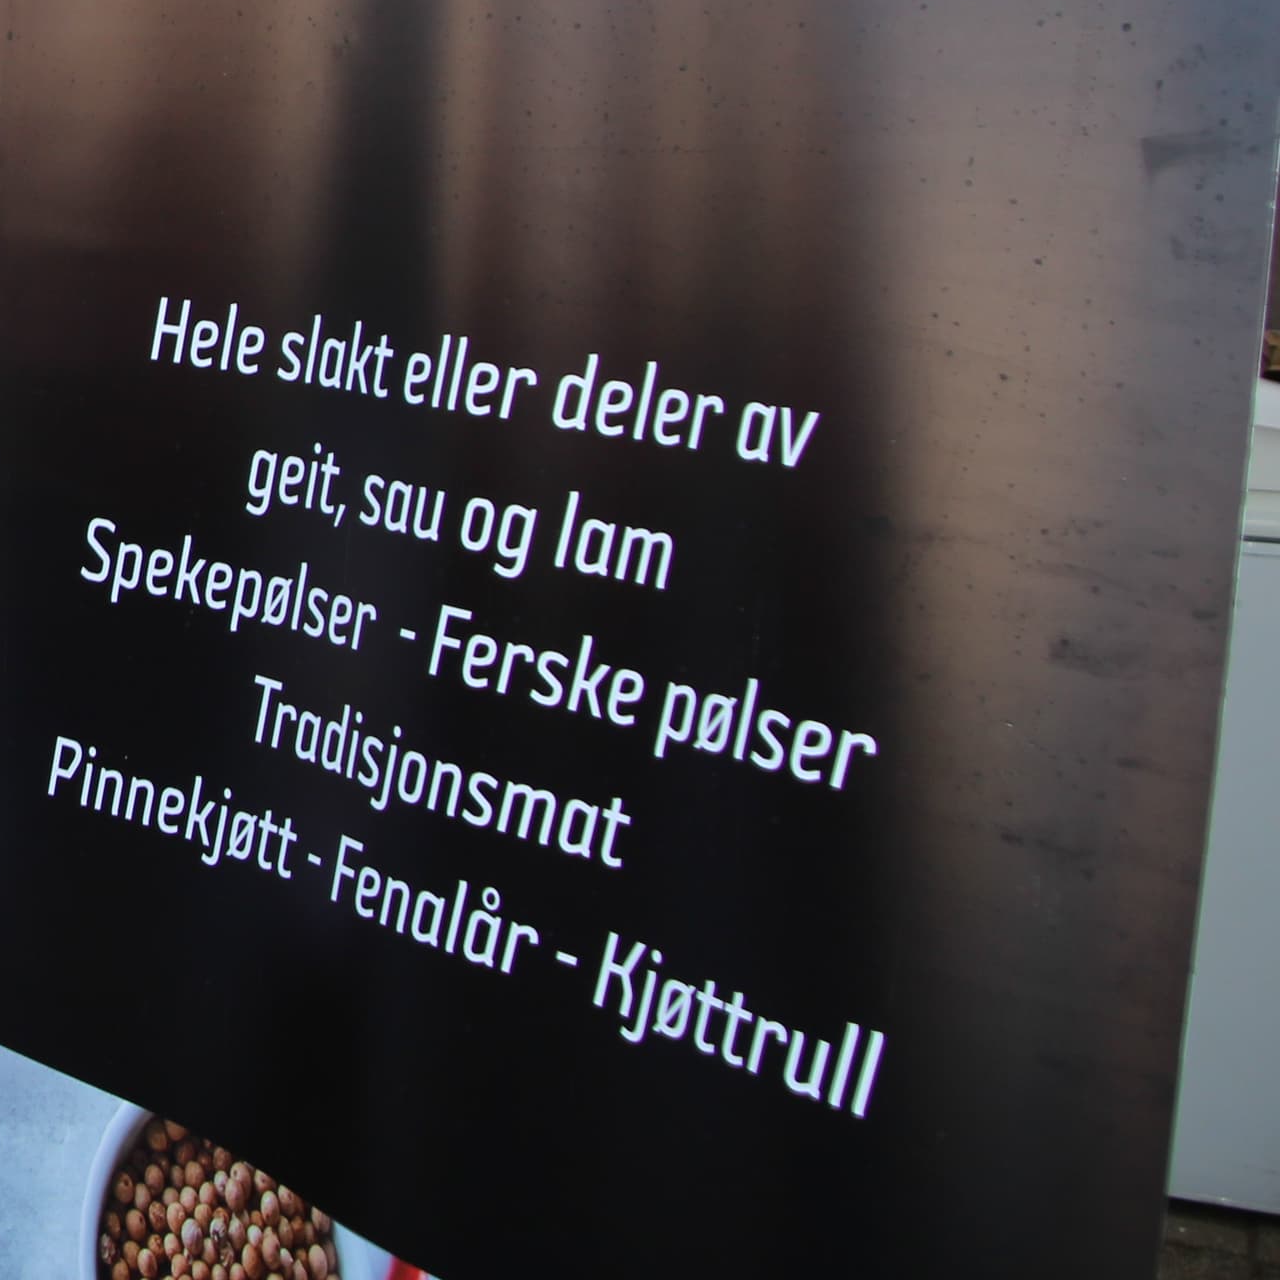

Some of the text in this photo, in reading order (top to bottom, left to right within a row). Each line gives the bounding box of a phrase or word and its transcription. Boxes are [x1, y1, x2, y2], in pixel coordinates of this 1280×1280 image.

[150, 296, 820, 467] Hele slakt eller deler av
[245, 443, 673, 590] geit, sau og lam
[80, 517, 377, 651] Spekepølser
[428, 604, 644, 726] Ferske
[654, 678, 877, 789] pølser
[253, 674, 631, 868] Tradisjonsmat
[47, 735, 298, 879] Pinnekjøtt
[330, 834, 539, 974] Fenalår
[593, 931, 884, 1117] Kjøttrull
